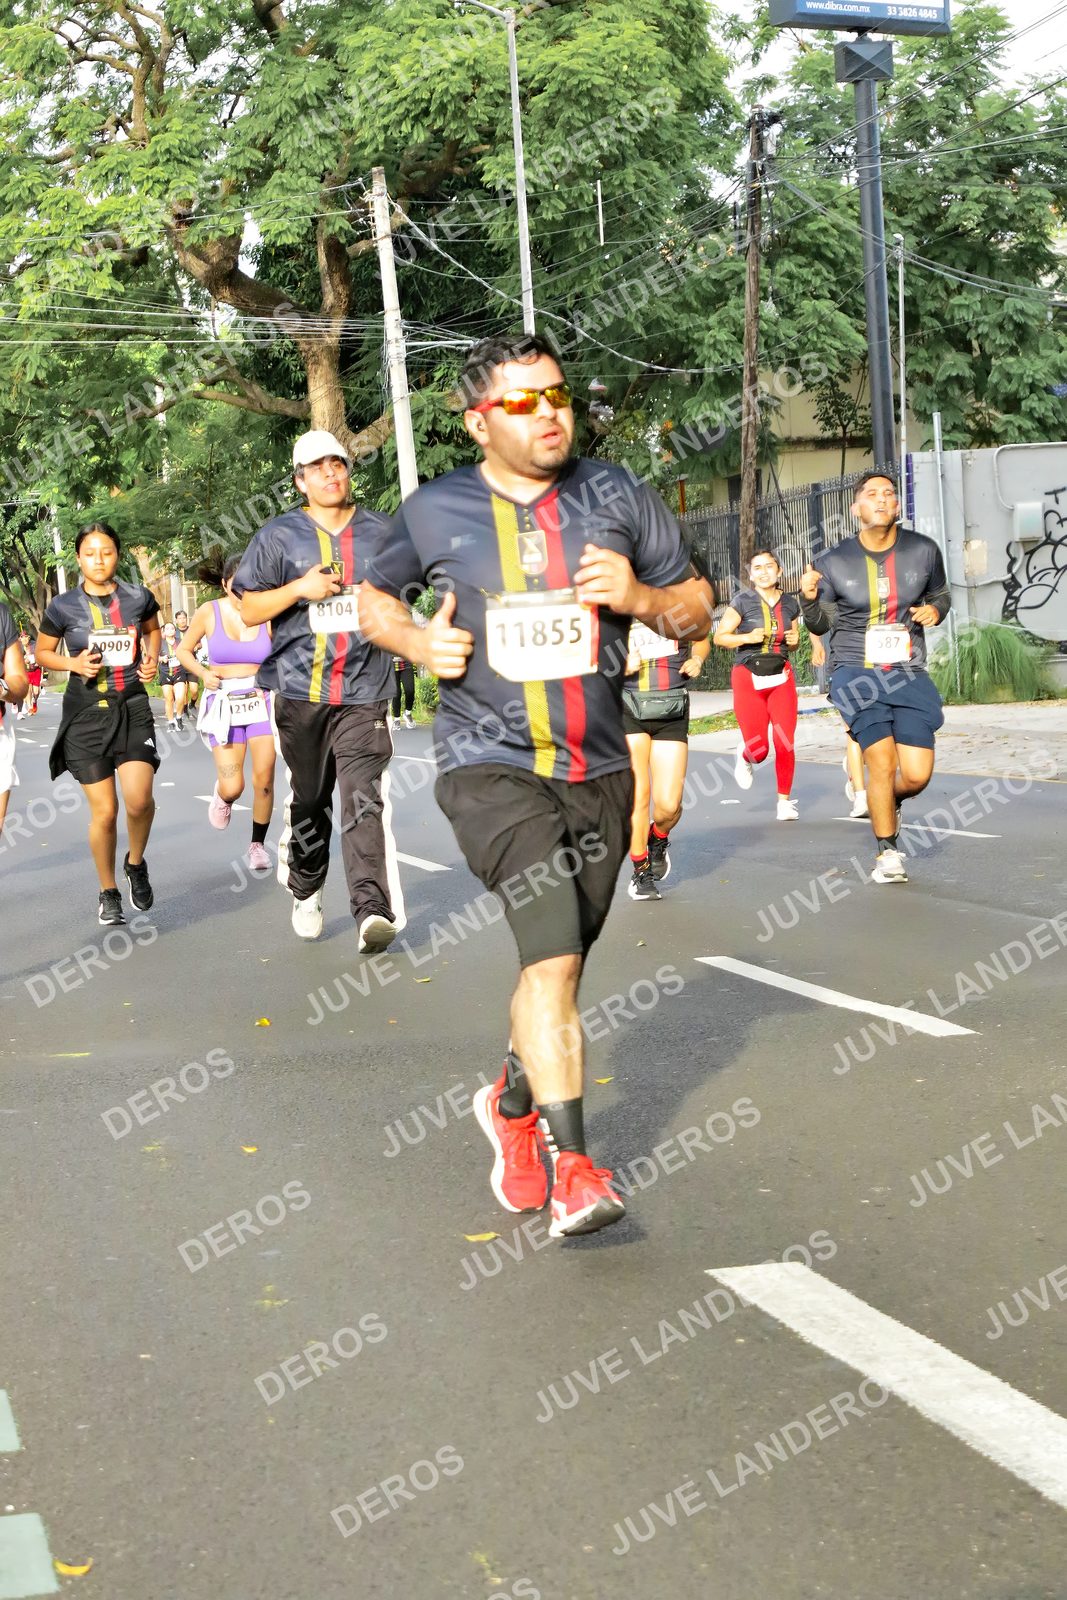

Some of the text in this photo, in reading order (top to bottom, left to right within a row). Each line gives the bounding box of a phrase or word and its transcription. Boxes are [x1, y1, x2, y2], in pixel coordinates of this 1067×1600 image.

[806, 1, 870, 14] www.dibra.com.mx
[887, 6, 897, 16] 33
[899, 6, 917, 17] 3826
[316, 601, 354, 617] 8104
[495, 617, 582, 648] 11855
